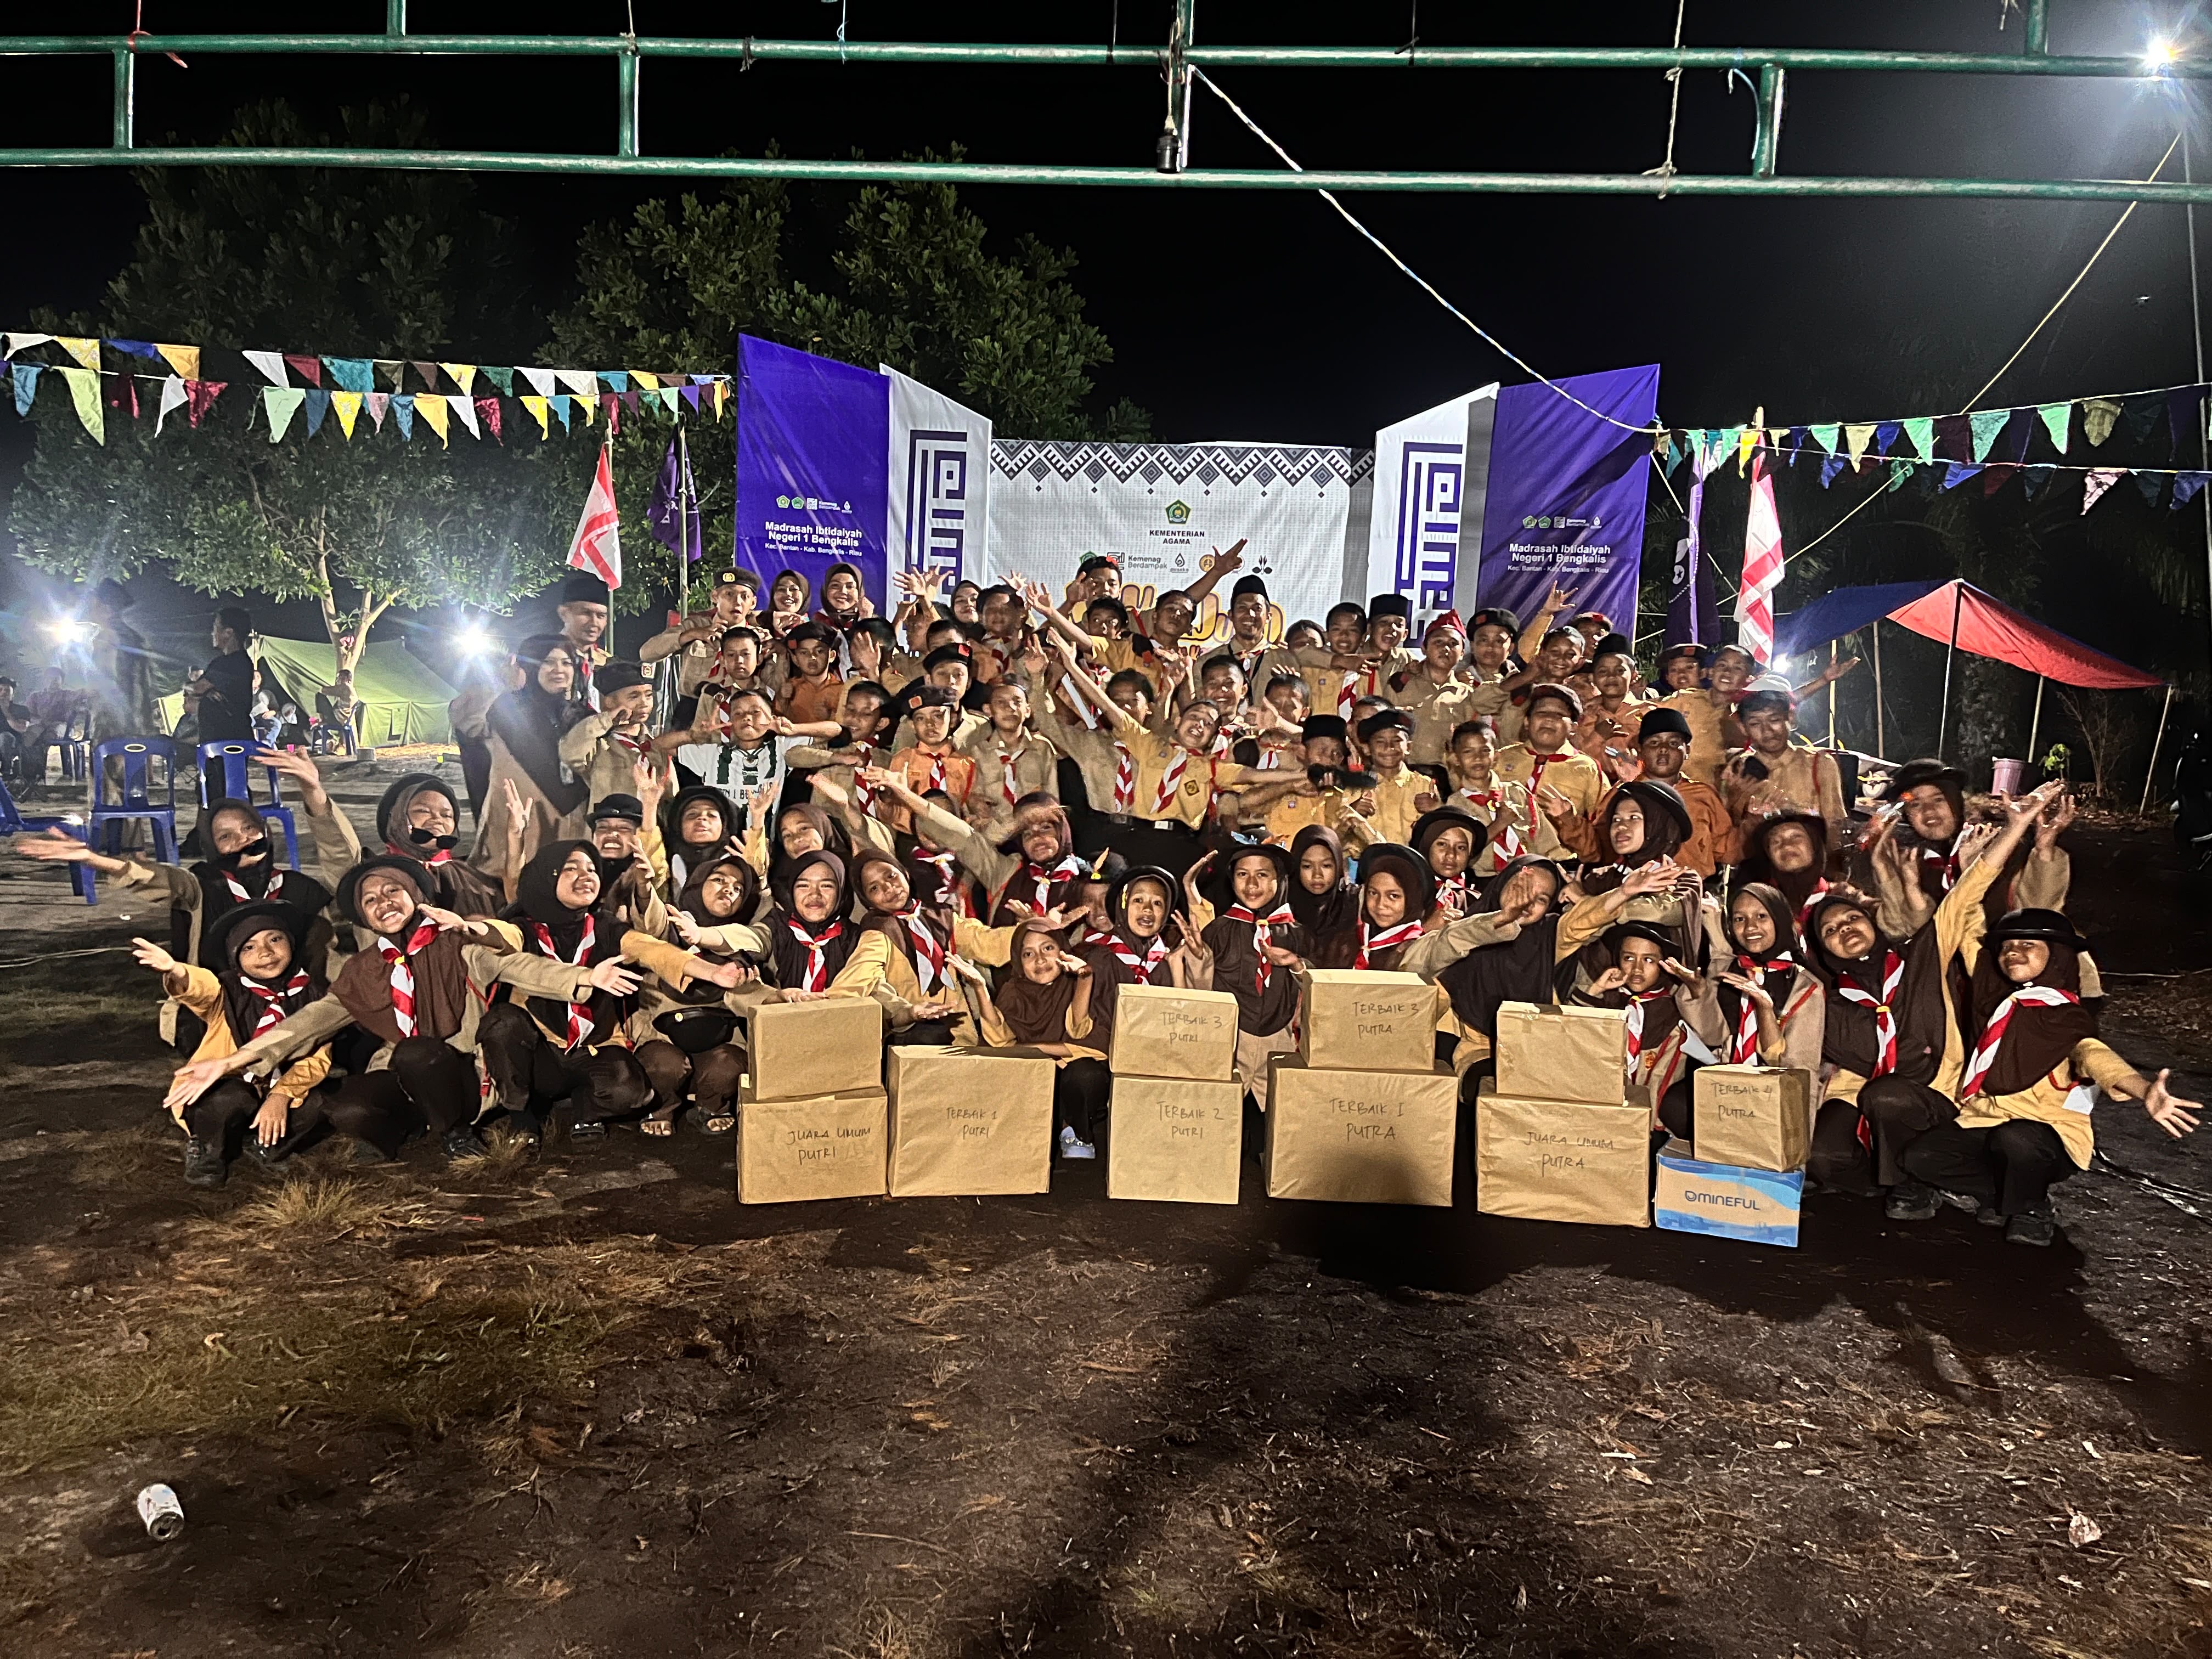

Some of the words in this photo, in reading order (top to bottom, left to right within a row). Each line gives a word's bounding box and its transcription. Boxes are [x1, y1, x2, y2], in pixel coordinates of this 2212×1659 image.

[765, 522, 813, 534] Madrasah
[815, 526, 862, 539] Ibtidaiyah
[1149, 529, 1205, 538] KEMENTERIAN
[769, 531, 800, 543] Negeri
[803, 534, 808, 543] 1
[811, 535, 859, 547] Bengkalis
[1509, 543, 1558, 552] Madrasah
[1561, 545, 1611, 556] Ibtidaiyah
[1127, 555, 1161, 563] Kemenag
[1127, 561, 1167, 569] Berdampak
[1511, 552, 1545, 563] Negeri
[1548, 554, 1553, 562] 1
[1556, 554, 1606, 565] Bengkalis
[1352, 1001, 1405, 1017] TERBAIK
[1410, 1003, 1419, 1017] 3
[1159, 1012, 1209, 1026] TERBAIK
[1213, 1015, 1222, 1029] 3
[1169, 1032, 1198, 1045] PUTRI
[1358, 1024, 1392, 1040] PUTRA
[1711, 1082, 1759, 1097] TERBAIK
[1763, 1085, 1773, 1102] 4
[946, 1107, 986, 1120] TERBAIK
[1156, 1101, 1205, 1121] TERBAIK
[1213, 1108, 1224, 1120] 2
[1329, 1097, 1387, 1115] TERBAIK
[1718, 1104, 1756, 1121] PUTRA
[786, 1130, 830, 1146] JUARA
[837, 1127, 871, 1138] UMUM
[963, 1125, 989, 1140] PUTRI
[1171, 1125, 1203, 1139] PUTRI
[1346, 1122, 1396, 1142] PUTRA
[1523, 1131, 1567, 1146] JUARA
[1576, 1137, 1614, 1150] UMUM
[798, 1146, 836, 1165] PUTRI
[1542, 1153, 1585, 1178] PUTRA
